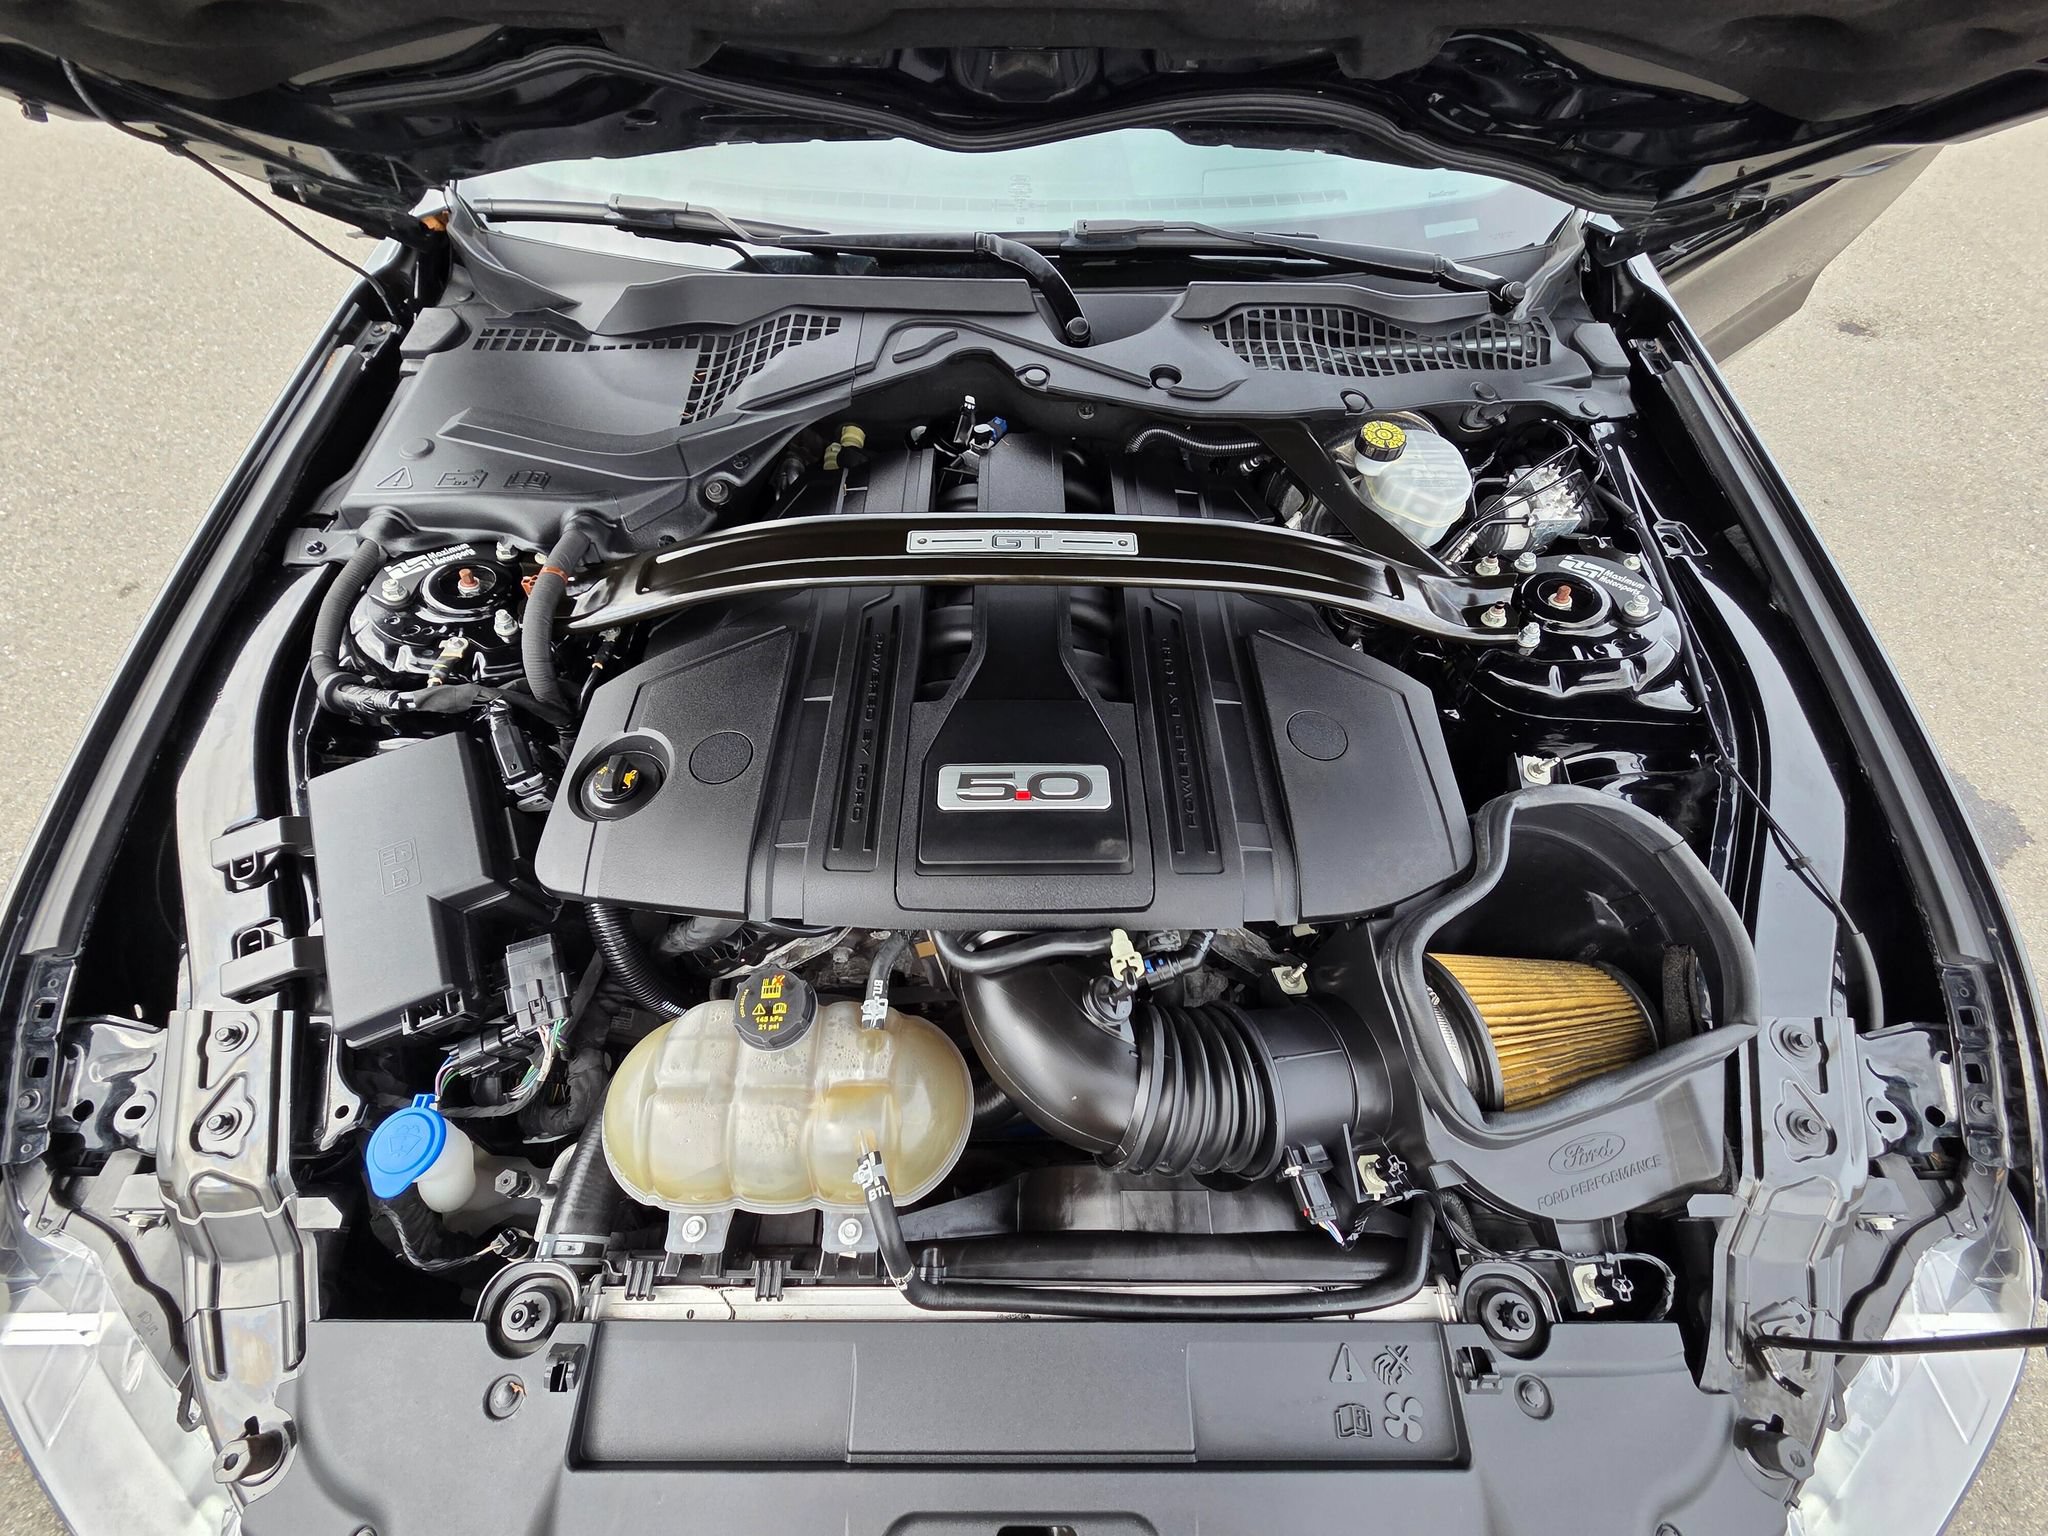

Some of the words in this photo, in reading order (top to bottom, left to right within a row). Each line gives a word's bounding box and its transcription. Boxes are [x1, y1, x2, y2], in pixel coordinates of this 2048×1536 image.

[427, 543, 470, 560] Maximum
[992, 534, 1053, 550] GT
[432, 548, 477, 566] Motorsports
[1598, 575, 1641, 596] Motorsports
[1603, 569, 1646, 590] Maximum
[956, 771, 1093, 802] 5.0
[1175, 726, 1199, 829] POWERED
[850, 763, 868, 823] FORD
[768, 1022, 780, 1031] psi
[1562, 1138, 1615, 1170] Ford
[1537, 1189, 1570, 1210] FORD
[1570, 1154, 1664, 1199] PERFORMANCE
[868, 1185, 890, 1202] BTL
